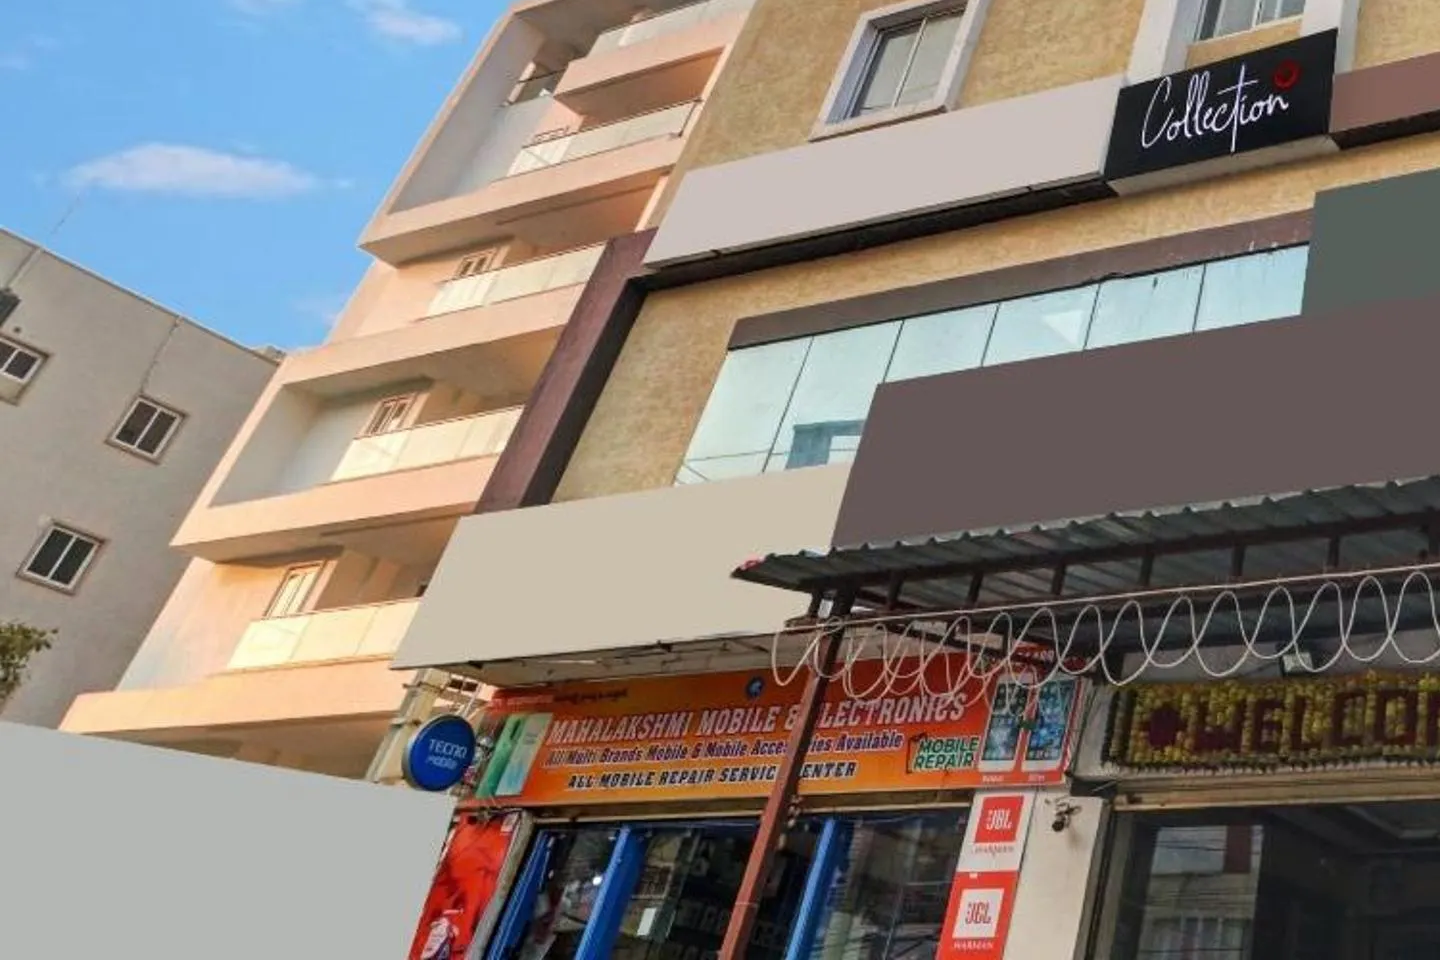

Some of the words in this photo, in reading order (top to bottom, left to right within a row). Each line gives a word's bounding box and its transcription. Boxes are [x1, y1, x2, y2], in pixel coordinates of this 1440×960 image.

[1141, 61, 1289, 153] Collection
[545, 711, 694, 746] MAHALAKSHMI
[696, 706, 782, 736] MOBILE
[818, 692, 968, 730] LECTRONICS
[599, 747, 642, 763] Brands
[647, 744, 688, 761] Mobile
[706, 740, 748, 758] Mobile
[836, 732, 903, 751] Available
[916, 737, 979, 754] MOBILE
[568, 774, 593, 788] ALL
[600, 771, 655, 787] MOBILE
[659, 768, 714, 785] REPAIR
[719, 766, 777, 783] SERVIC
[801, 761, 857, 779] ENTER
[914, 752, 975, 770] REPAIR
[986, 808, 1012, 831] JBL
